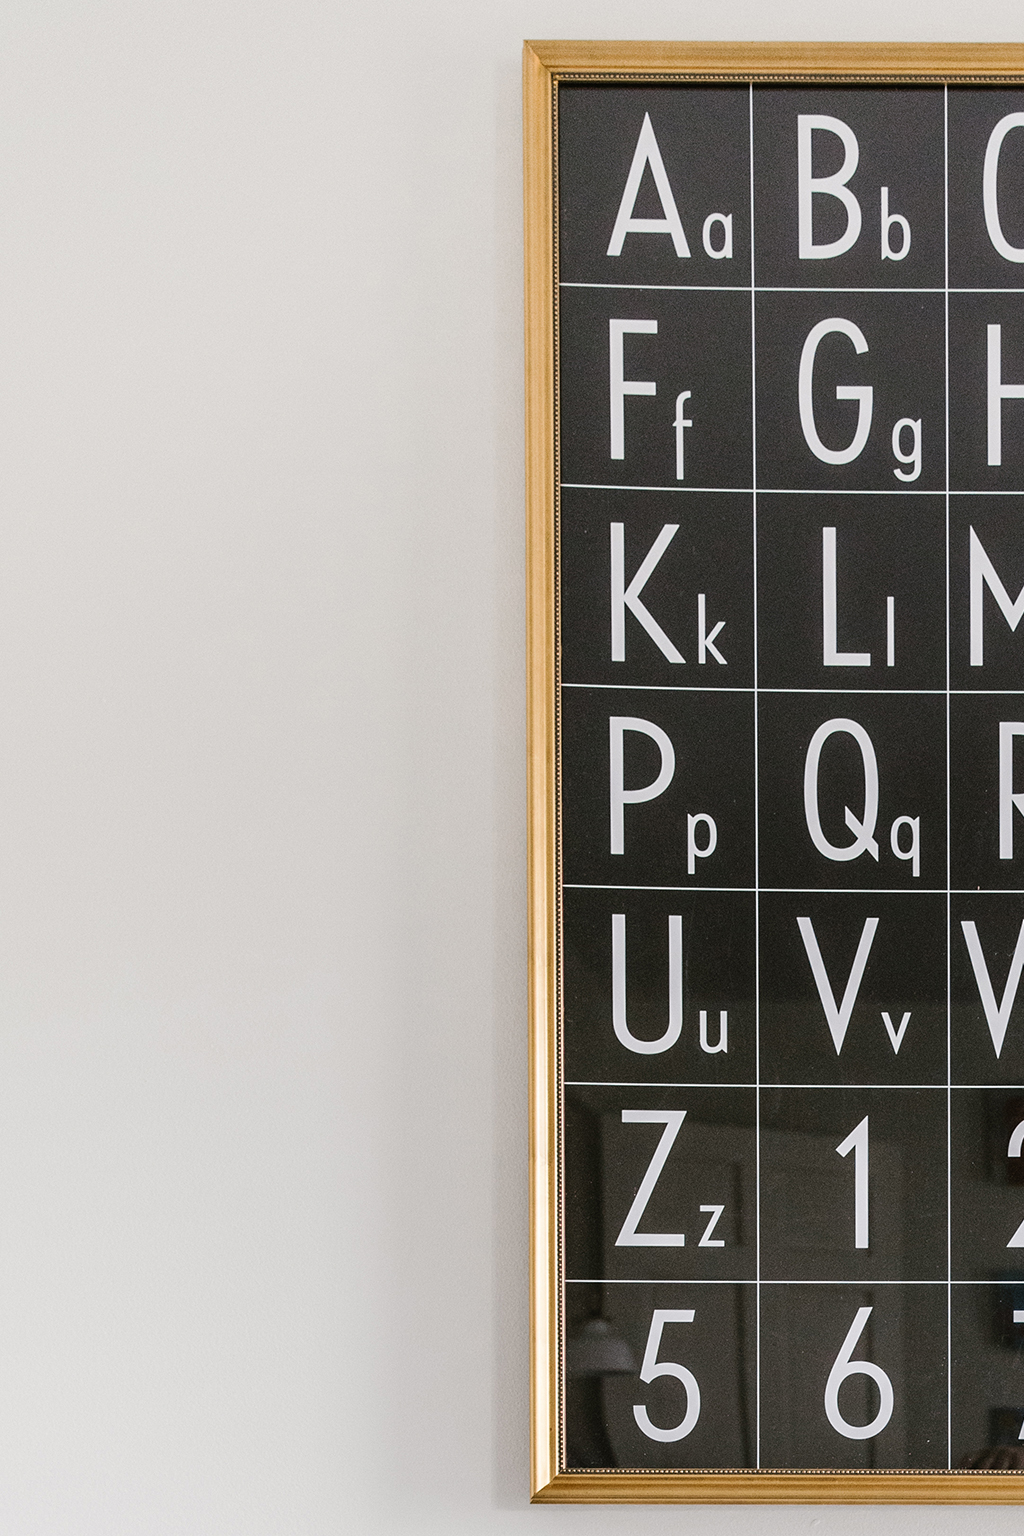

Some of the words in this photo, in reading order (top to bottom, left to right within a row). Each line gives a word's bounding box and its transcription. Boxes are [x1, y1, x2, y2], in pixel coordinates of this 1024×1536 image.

[835, 1115, 869, 1249] 1
[632, 1309, 701, 1443] 5
[824, 1306, 895, 1440] 6
